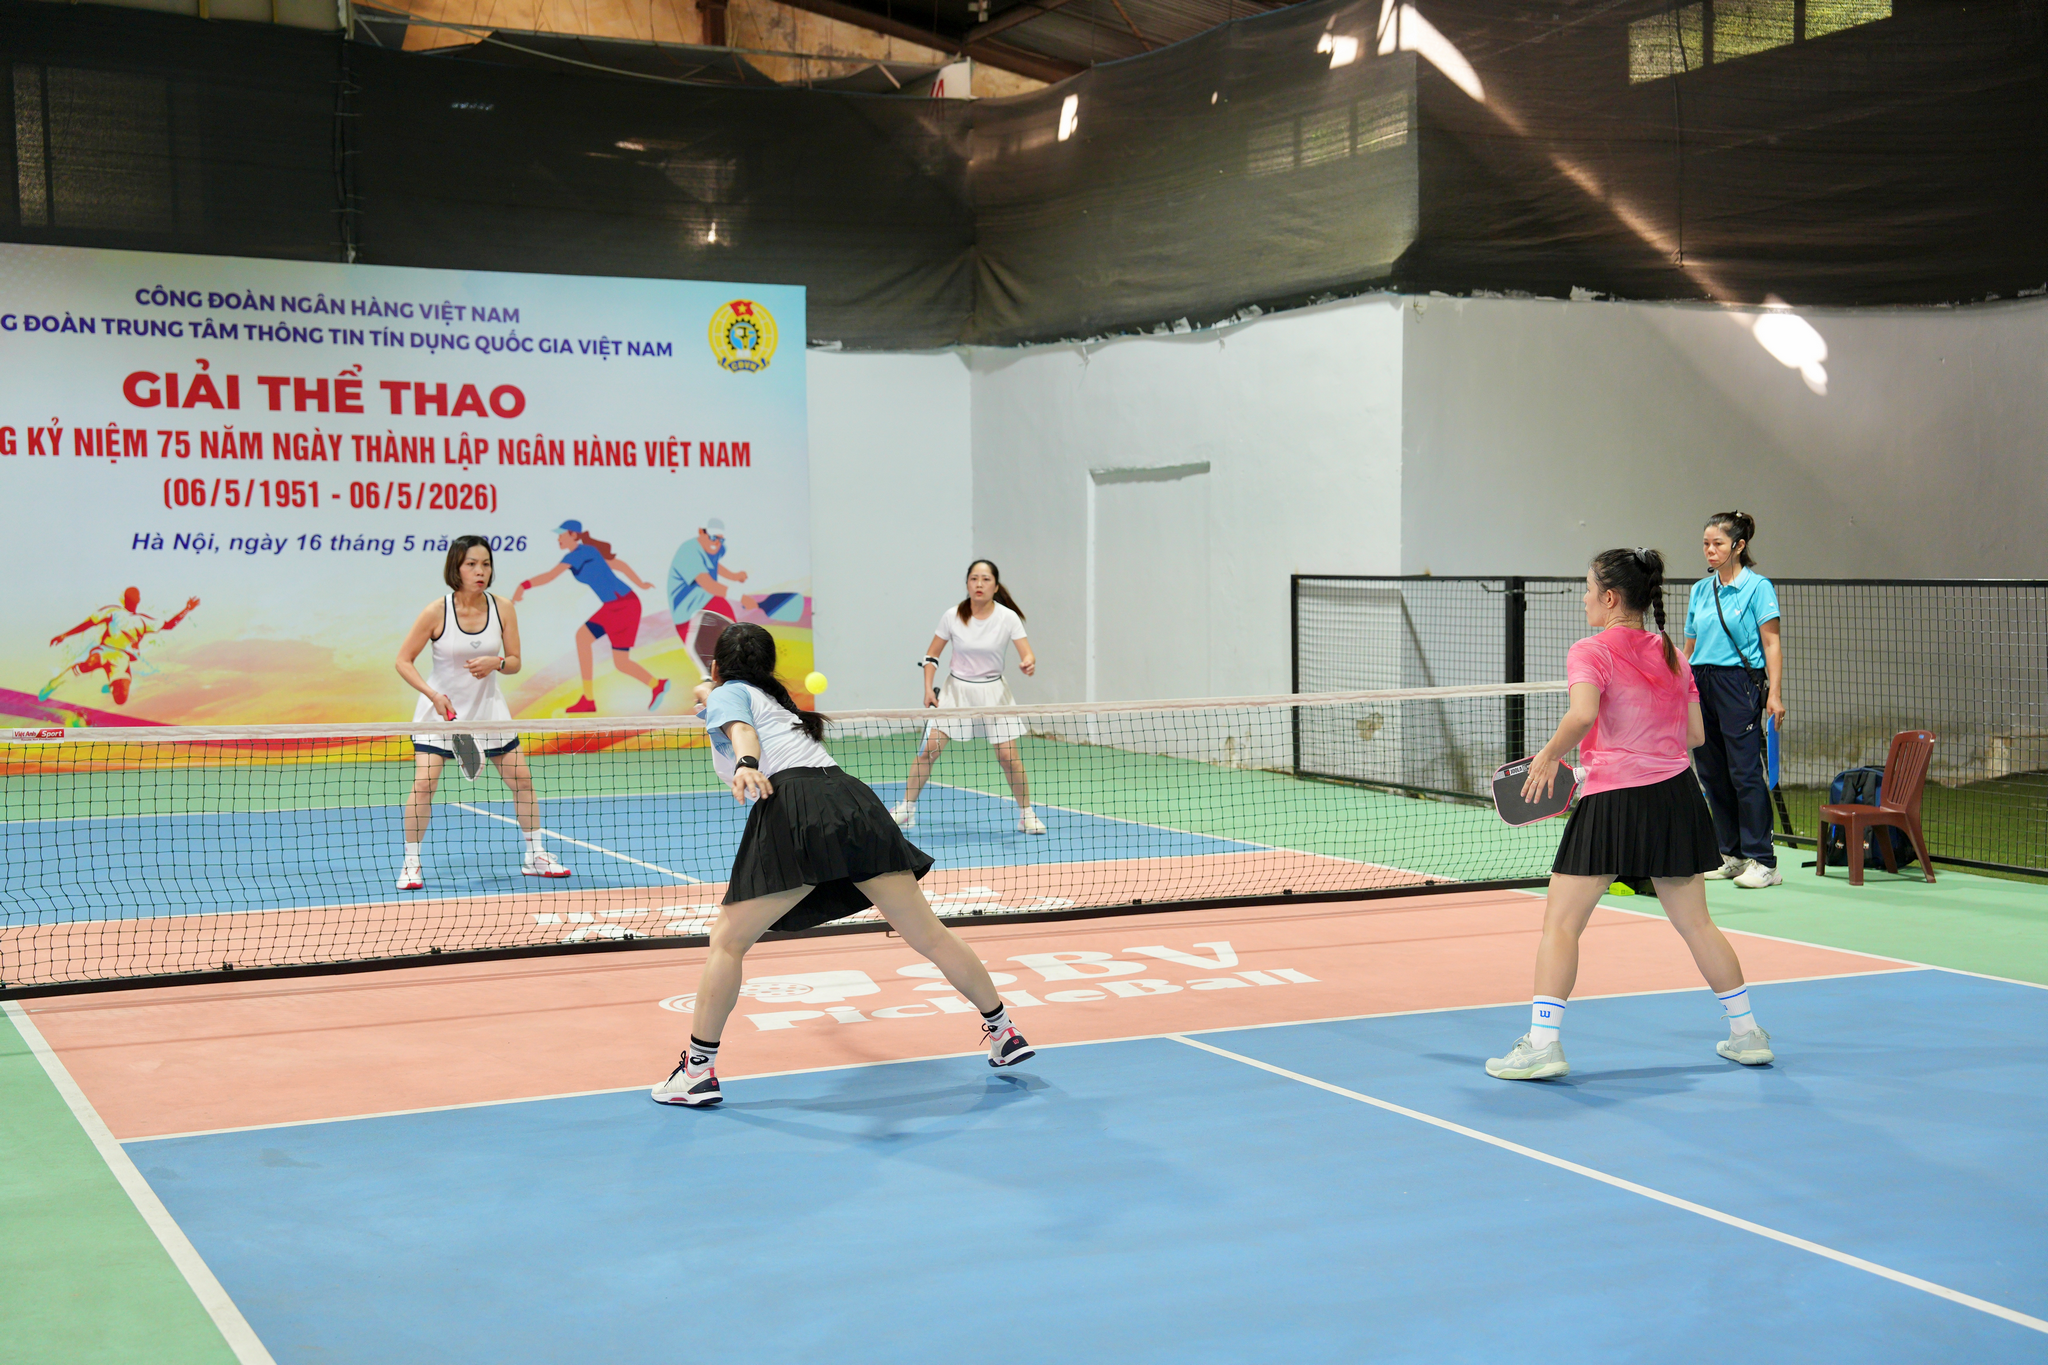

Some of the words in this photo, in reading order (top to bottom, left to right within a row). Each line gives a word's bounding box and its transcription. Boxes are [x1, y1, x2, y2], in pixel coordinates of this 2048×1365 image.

[135, 284, 203, 308] CÔNG
[207, 288, 276, 312] ĐOÀN
[280, 292, 347, 315] NGÂN
[351, 294, 414, 319] HÀNG
[419, 300, 468, 325] VIỆT
[471, 307, 520, 324] NAM
[23, 311, 97, 334] ĐOÀN
[101, 318, 184, 338] TRUNG
[189, 318, 239, 341] TÂM
[243, 322, 325, 345] THÔNG
[328, 328, 364, 346] TIN
[369, 327, 404, 348] TÍN
[410, 333, 471, 356] DỤNG
[475, 329, 534, 355] QUỐC
[539, 338, 574, 355] GIA
[578, 336, 623, 360] VIỆT
[627, 341, 673, 358] NAM
[122, 358, 241, 410] GIẢI
[257, 364, 365, 414] THỂ
[379, 381, 527, 419] THAO
[27, 416, 64, 456] KỶ
[74, 422, 148, 464] NIỆM
[157, 430, 191, 459] 75
[200, 424, 263, 460] NĂM
[273, 427, 343, 462] NGÀY
[351, 429, 436, 464] THÀNH
[444, 432, 489, 471] LẬP
[498, 434, 565, 466] NGÂN
[574, 435, 637, 467] HÀNG
[644, 436, 692, 473] VIỆT
[700, 441, 751, 468] NAM
[132, 532, 165, 551] Hà
[173, 532, 220, 555] Nội,
[229, 533, 288, 555] ngày
[297, 533, 322, 551] 16
[330, 534, 395, 556] tháng
[403, 535, 415, 552] 5
[422, 534, 454, 552] nă
